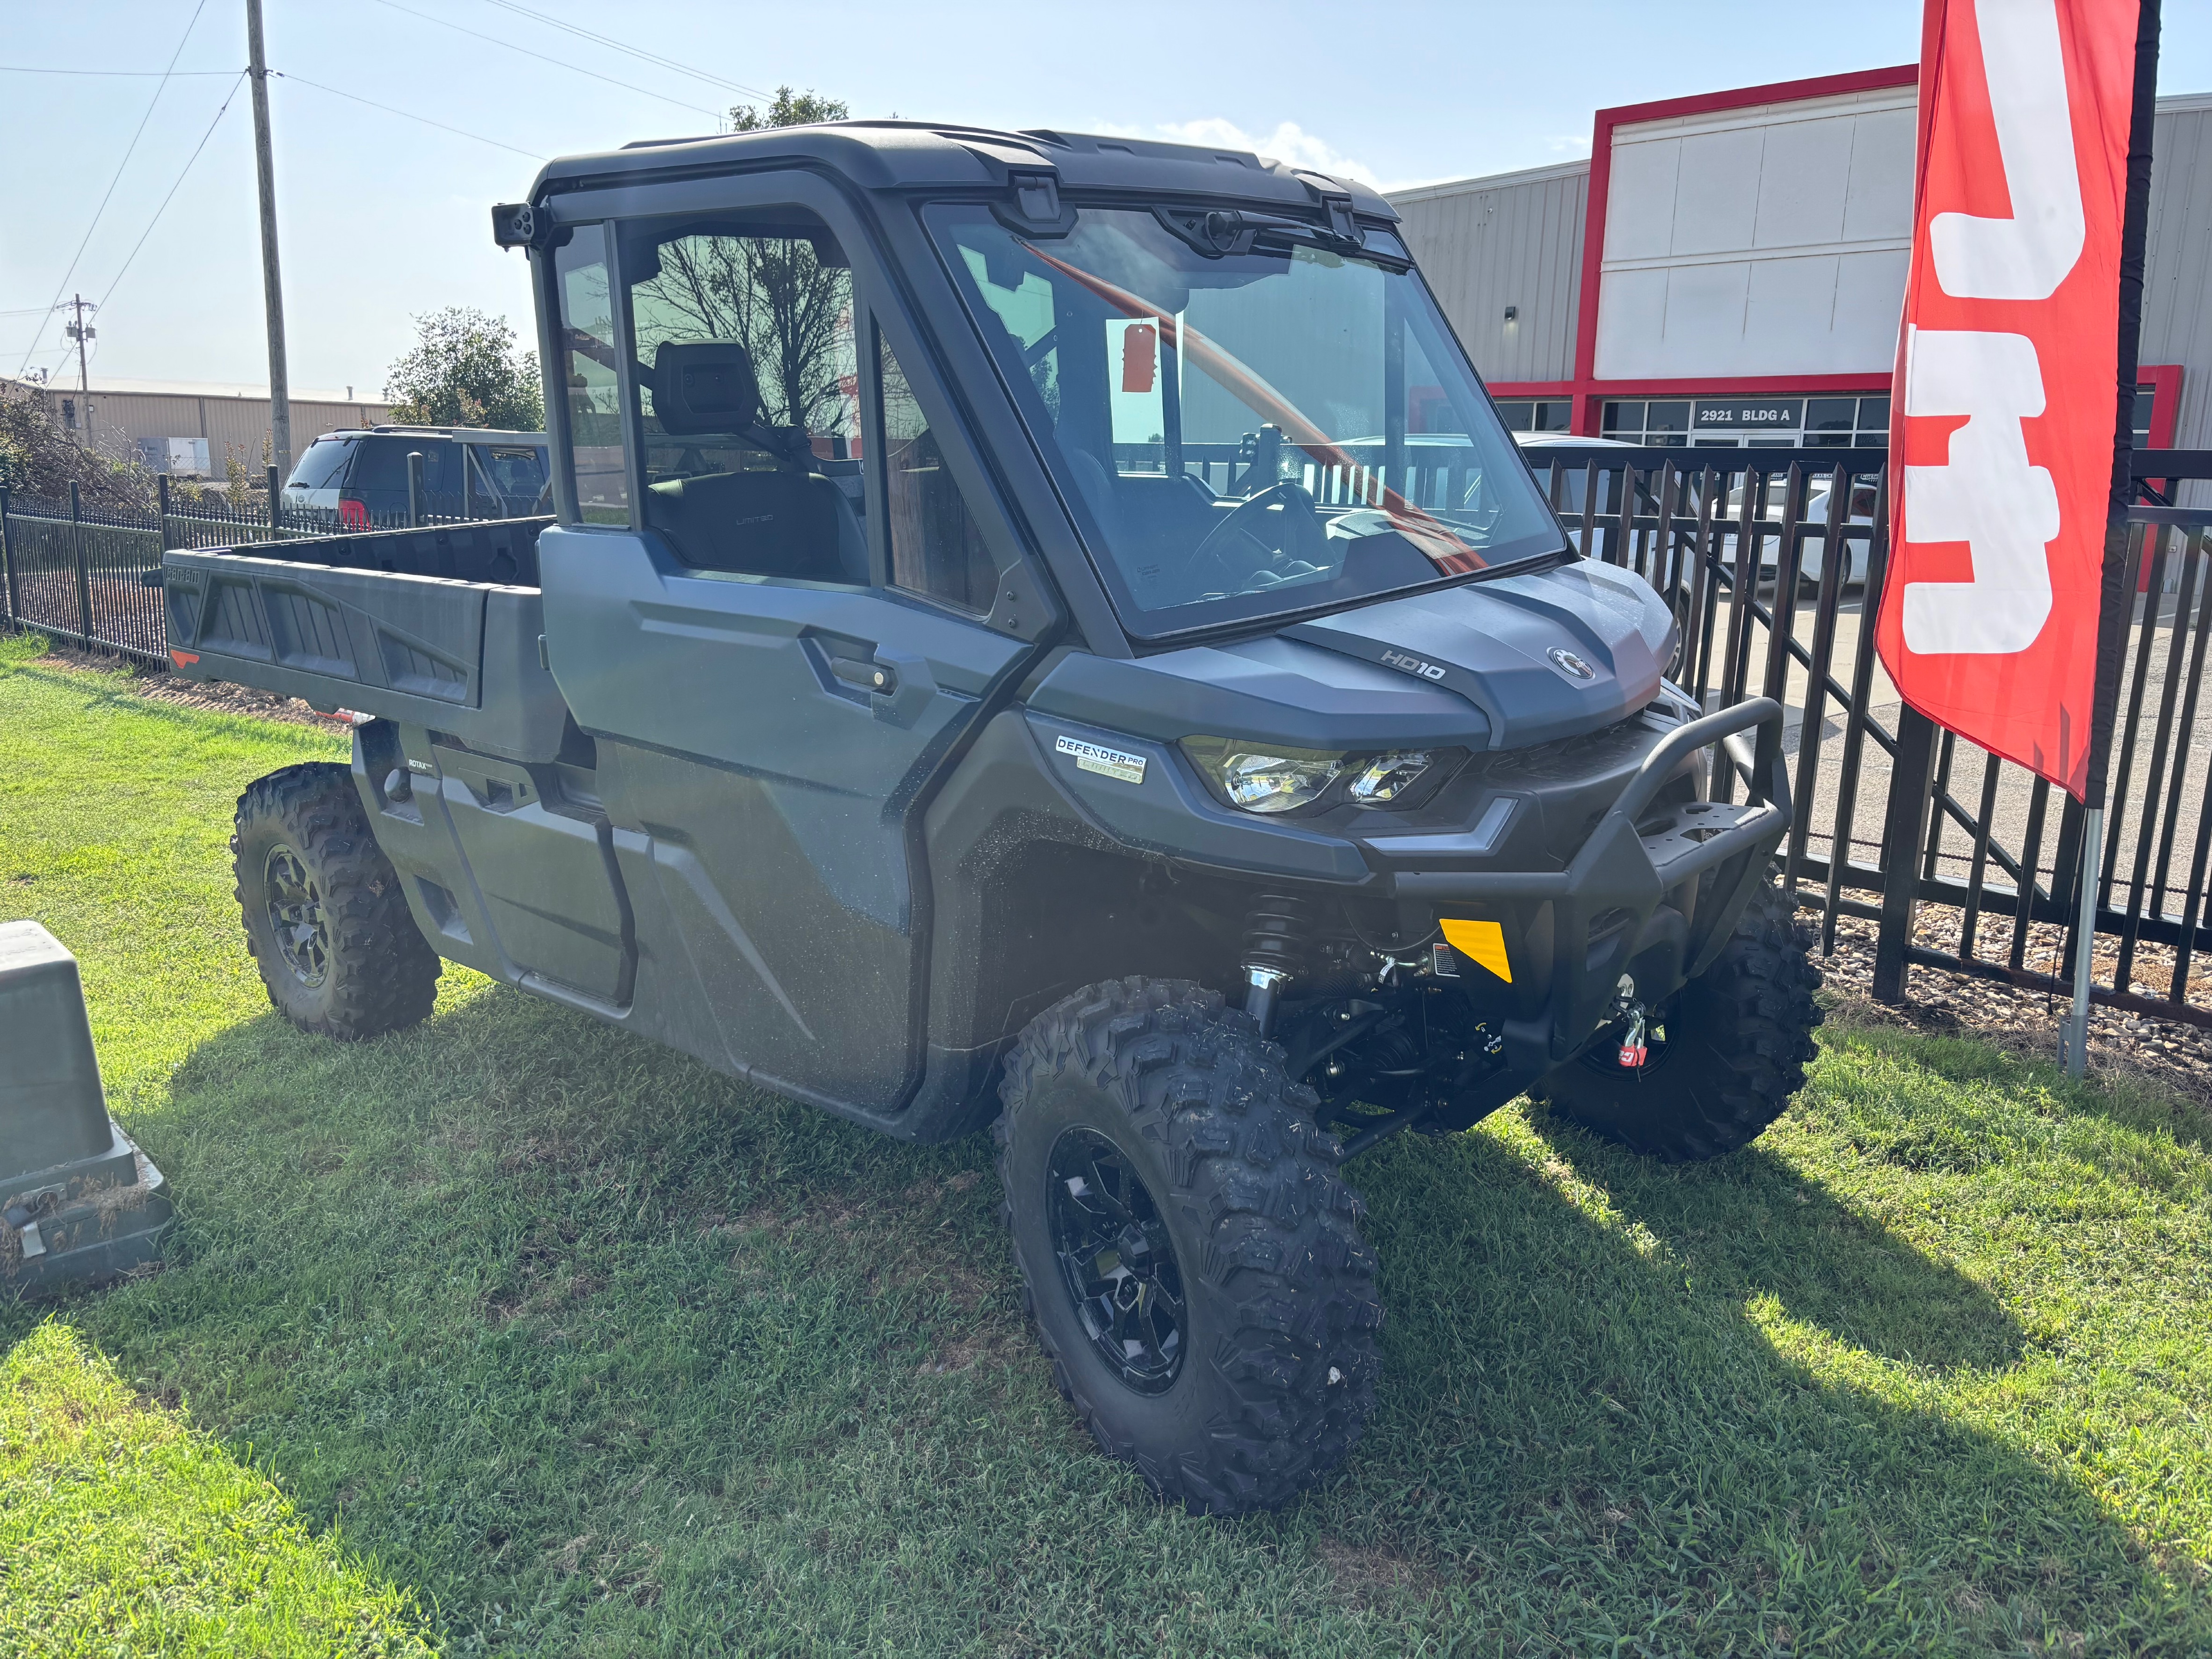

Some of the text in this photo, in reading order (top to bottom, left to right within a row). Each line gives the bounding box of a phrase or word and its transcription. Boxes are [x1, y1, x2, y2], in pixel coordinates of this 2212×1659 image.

[1701, 409, 1790, 421] 2921 BLDG A
[736, 515, 774, 525] LIMITED
[166, 567, 200, 584] can-am
[1380, 650, 1446, 679] HD10
[1058, 738, 1127, 764] DEFENDER
[409, 759, 427, 770] ROTAX
